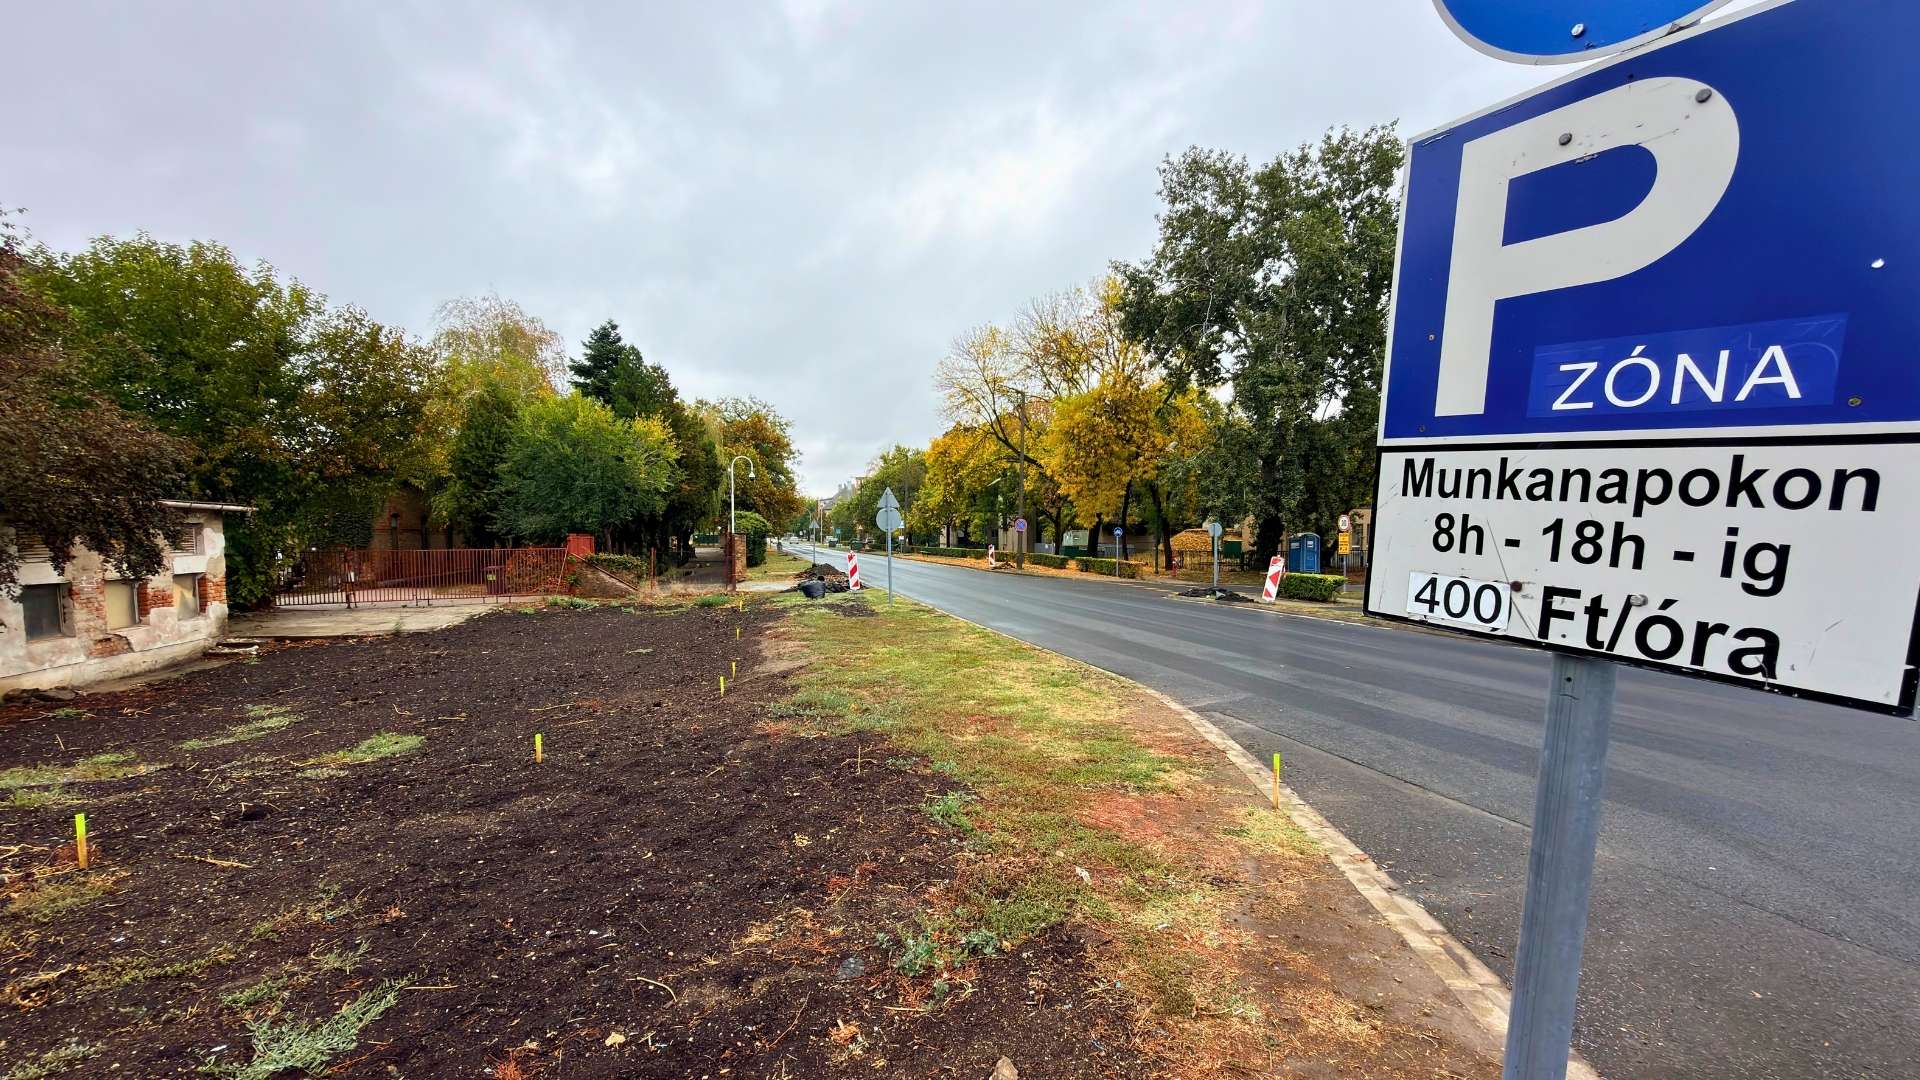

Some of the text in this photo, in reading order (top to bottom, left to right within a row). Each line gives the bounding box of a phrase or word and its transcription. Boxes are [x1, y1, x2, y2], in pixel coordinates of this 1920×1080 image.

[1435, 76, 1740, 417] P
[1552, 345, 1802, 411] ZÓNA
[1401, 454, 1881, 517] Munkanapokon
[1432, 512, 1485, 556] 8h
[1541, 517, 1646, 570] 18h
[1720, 526, 1792, 597] ig
[1413, 576, 1781, 679] 400 Ft/óra
